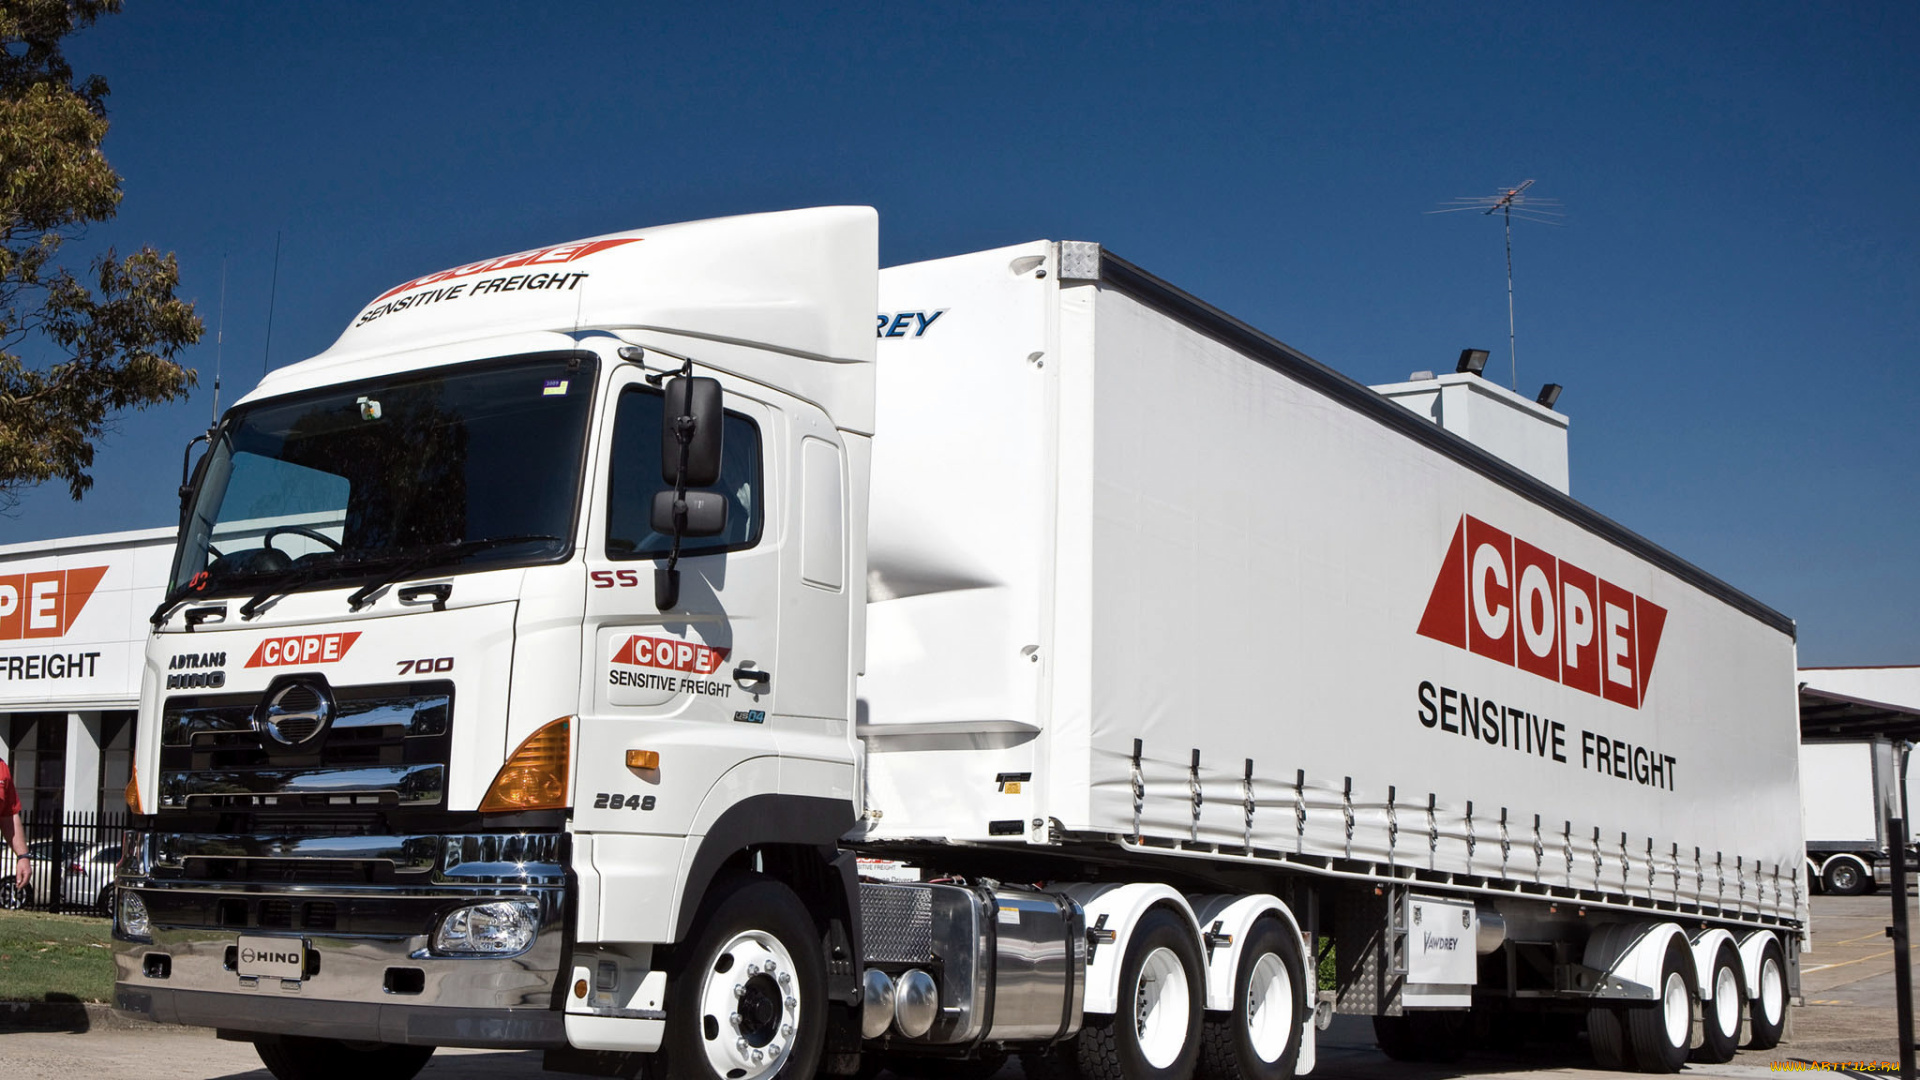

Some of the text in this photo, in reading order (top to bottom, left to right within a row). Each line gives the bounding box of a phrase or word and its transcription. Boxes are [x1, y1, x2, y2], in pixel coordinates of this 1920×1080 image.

[356, 272, 589, 328] SENSITIVE FREIGHT
[1472, 542, 1633, 689] COPE
[168, 651, 227, 670] ADTRANS
[264, 636, 343, 664] COPE
[634, 638, 712, 671] COPE
[166, 670, 226, 690] HINO
[396, 657, 455, 675] 700
[608, 669, 732, 698] SENSITIVE FREIGHT
[1418, 680, 1677, 792] SENSITIVE FREIGHT
[593, 793, 657, 811] 2848
[257, 951, 300, 964] HINO
